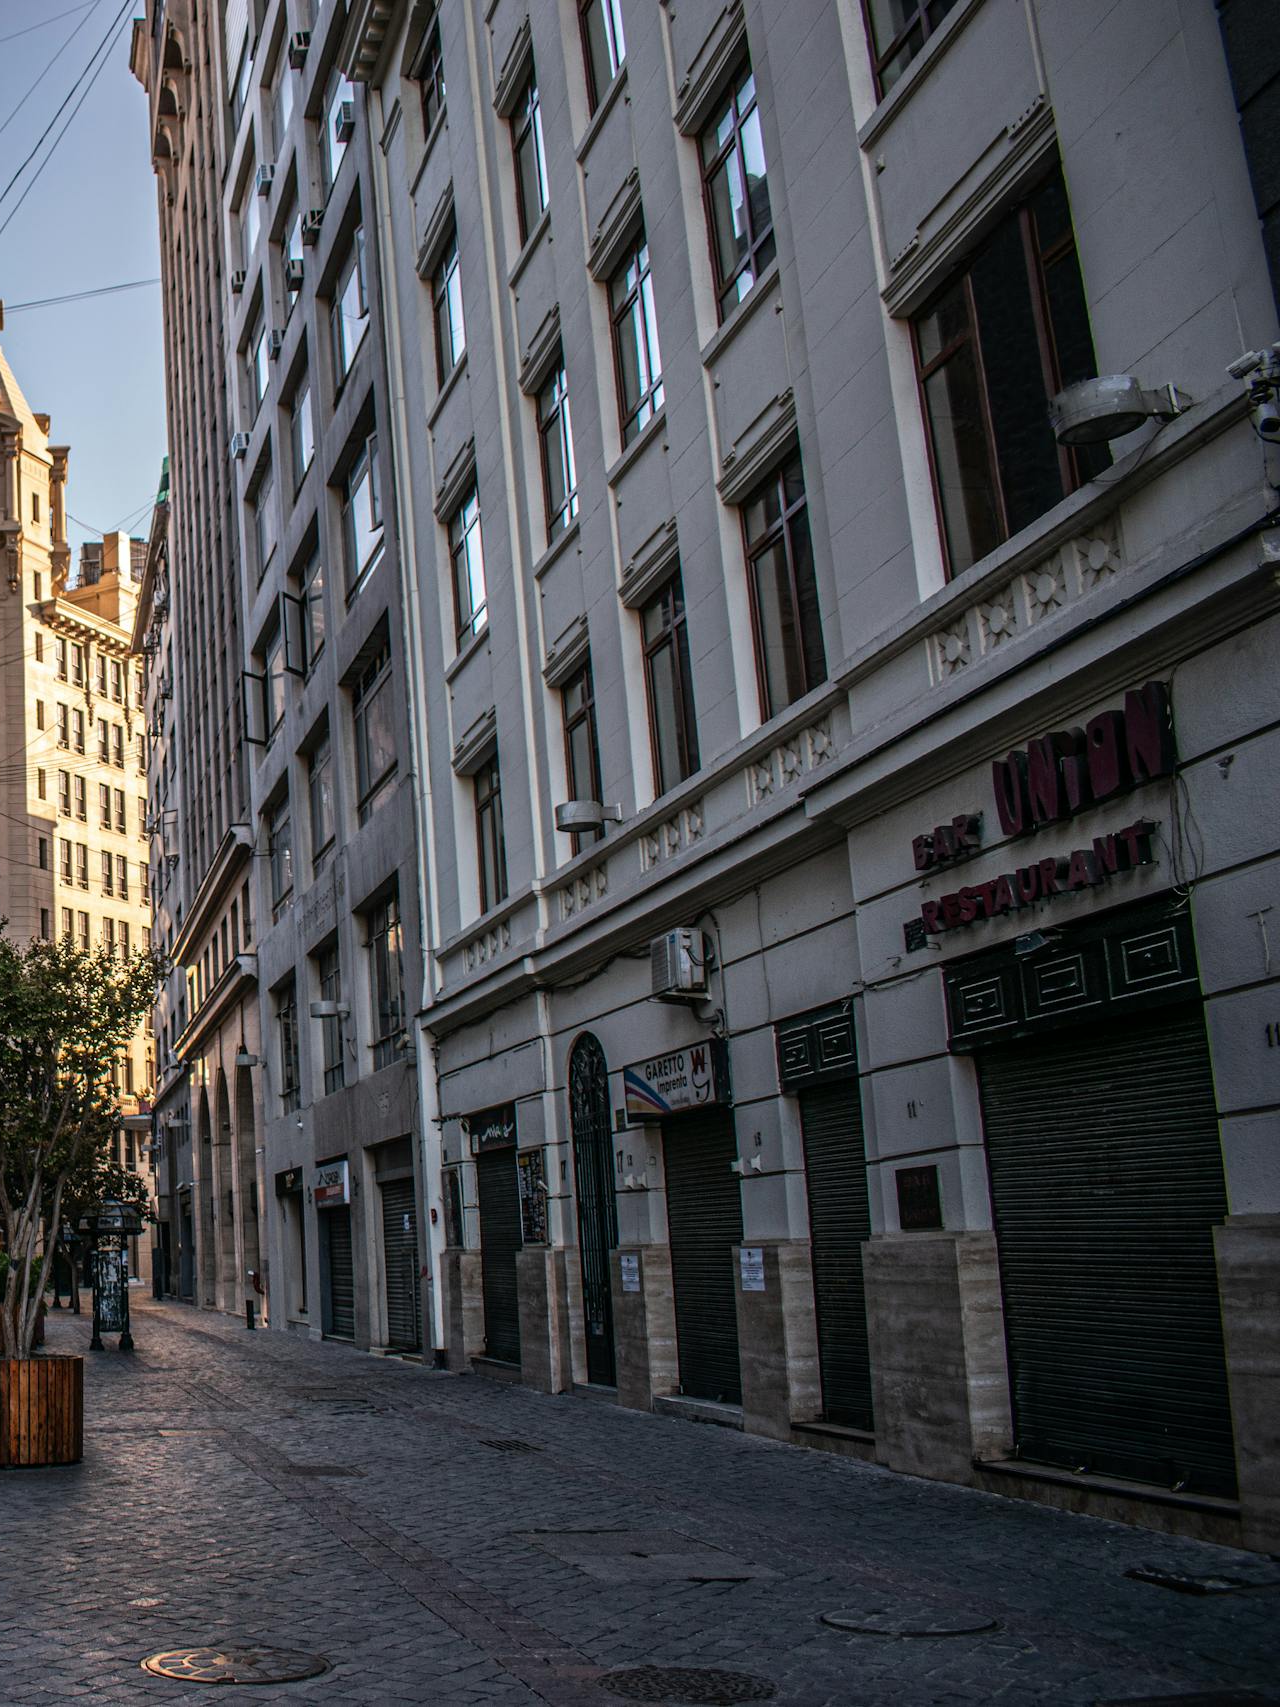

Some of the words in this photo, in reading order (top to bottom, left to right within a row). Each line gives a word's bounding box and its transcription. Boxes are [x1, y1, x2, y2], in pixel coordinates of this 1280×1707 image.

[913, 814, 982, 871] BAR
[921, 820, 1155, 934] RESTAURANT
[645, 1054, 684, 1081] GARETTO
